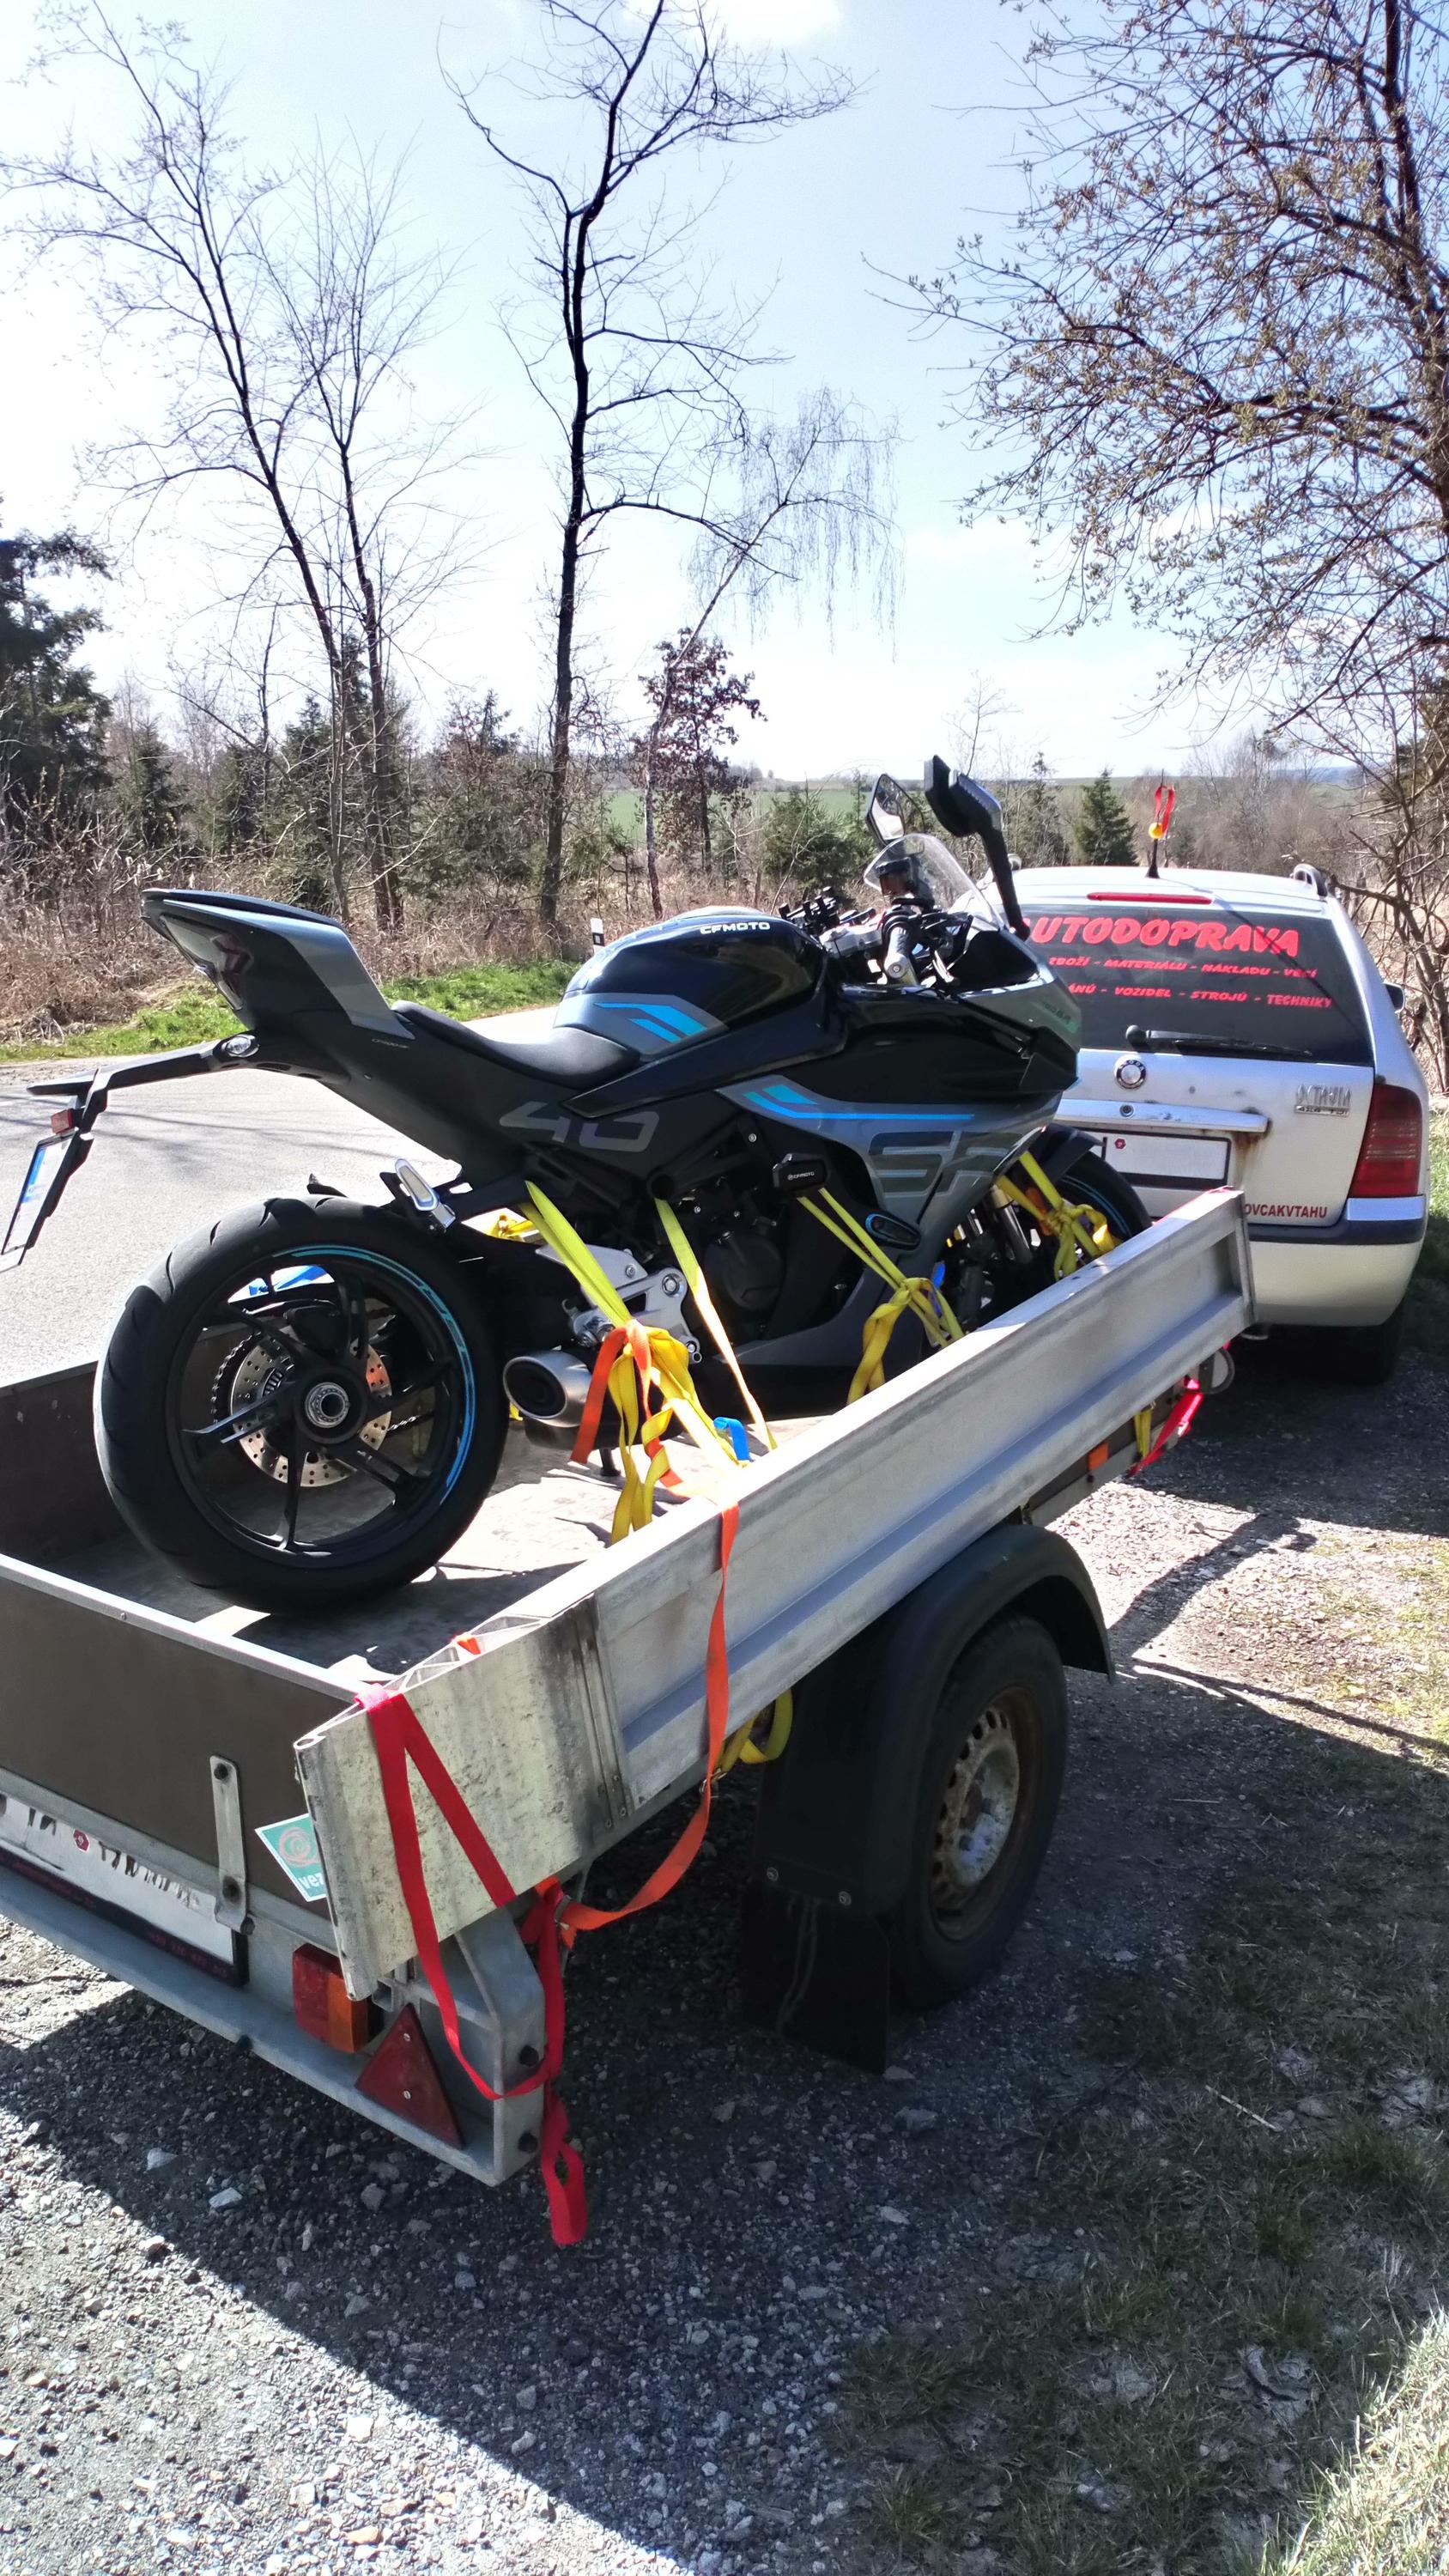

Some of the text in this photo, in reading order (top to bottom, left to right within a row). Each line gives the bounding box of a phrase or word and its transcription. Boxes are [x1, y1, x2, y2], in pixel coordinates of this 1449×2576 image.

[700, 921, 771, 934] CFMOTO
[1023, 916, 1300, 957] UTODOPRAVA
[1114, 987, 1173, 999] VOZIDEL
[1267, 993, 1332, 1008] TECHNIKY
[1297, 1084, 1352, 1107] OCTAVIA
